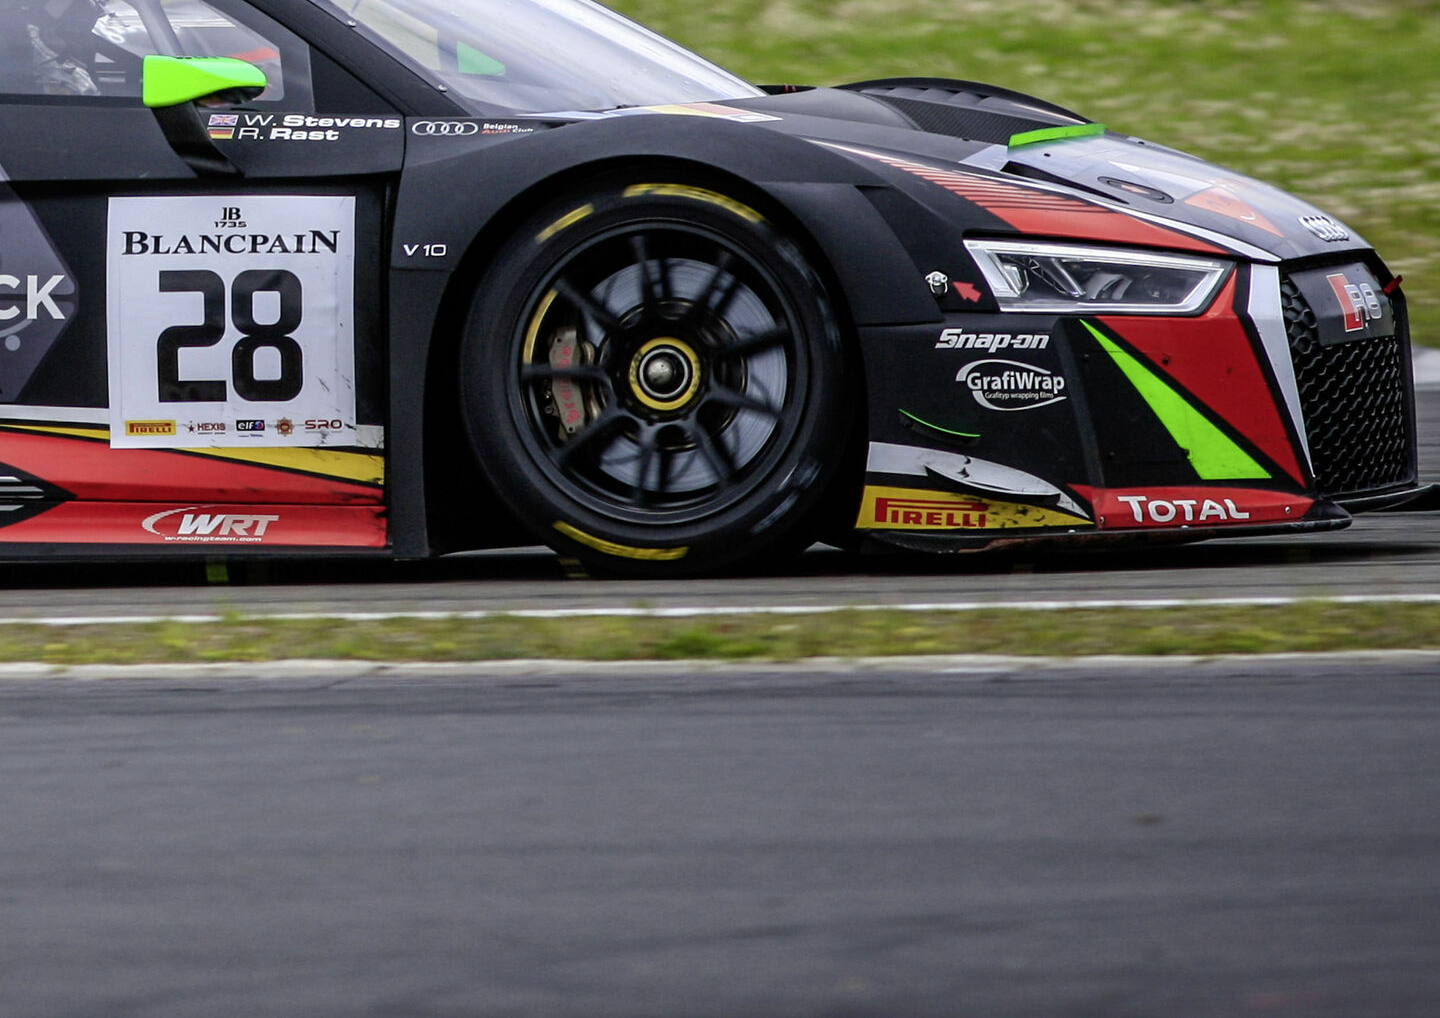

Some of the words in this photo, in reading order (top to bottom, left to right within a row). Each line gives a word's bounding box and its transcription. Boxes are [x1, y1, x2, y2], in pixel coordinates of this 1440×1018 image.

[244, 115, 276, 127] W.
[283, 115, 401, 128] Stevens
[238, 128, 264, 140] R.
[269, 128, 340, 141] Rast
[122, 230, 341, 256] BLANCPAIN
[157, 269, 303, 403] 28
[935, 328, 1050, 353] Snap-on
[966, 370, 1065, 394] GrafiWrap
[129, 422, 172, 433] PIRELLI
[198, 422, 226, 431] HEXIS
[238, 421, 254, 430] elf
[305, 419, 342, 429] SRO
[875, 497, 989, 528] PIRELLI
[1117, 495, 1250, 523] TOTAL
[177, 513, 280, 536] WRT
